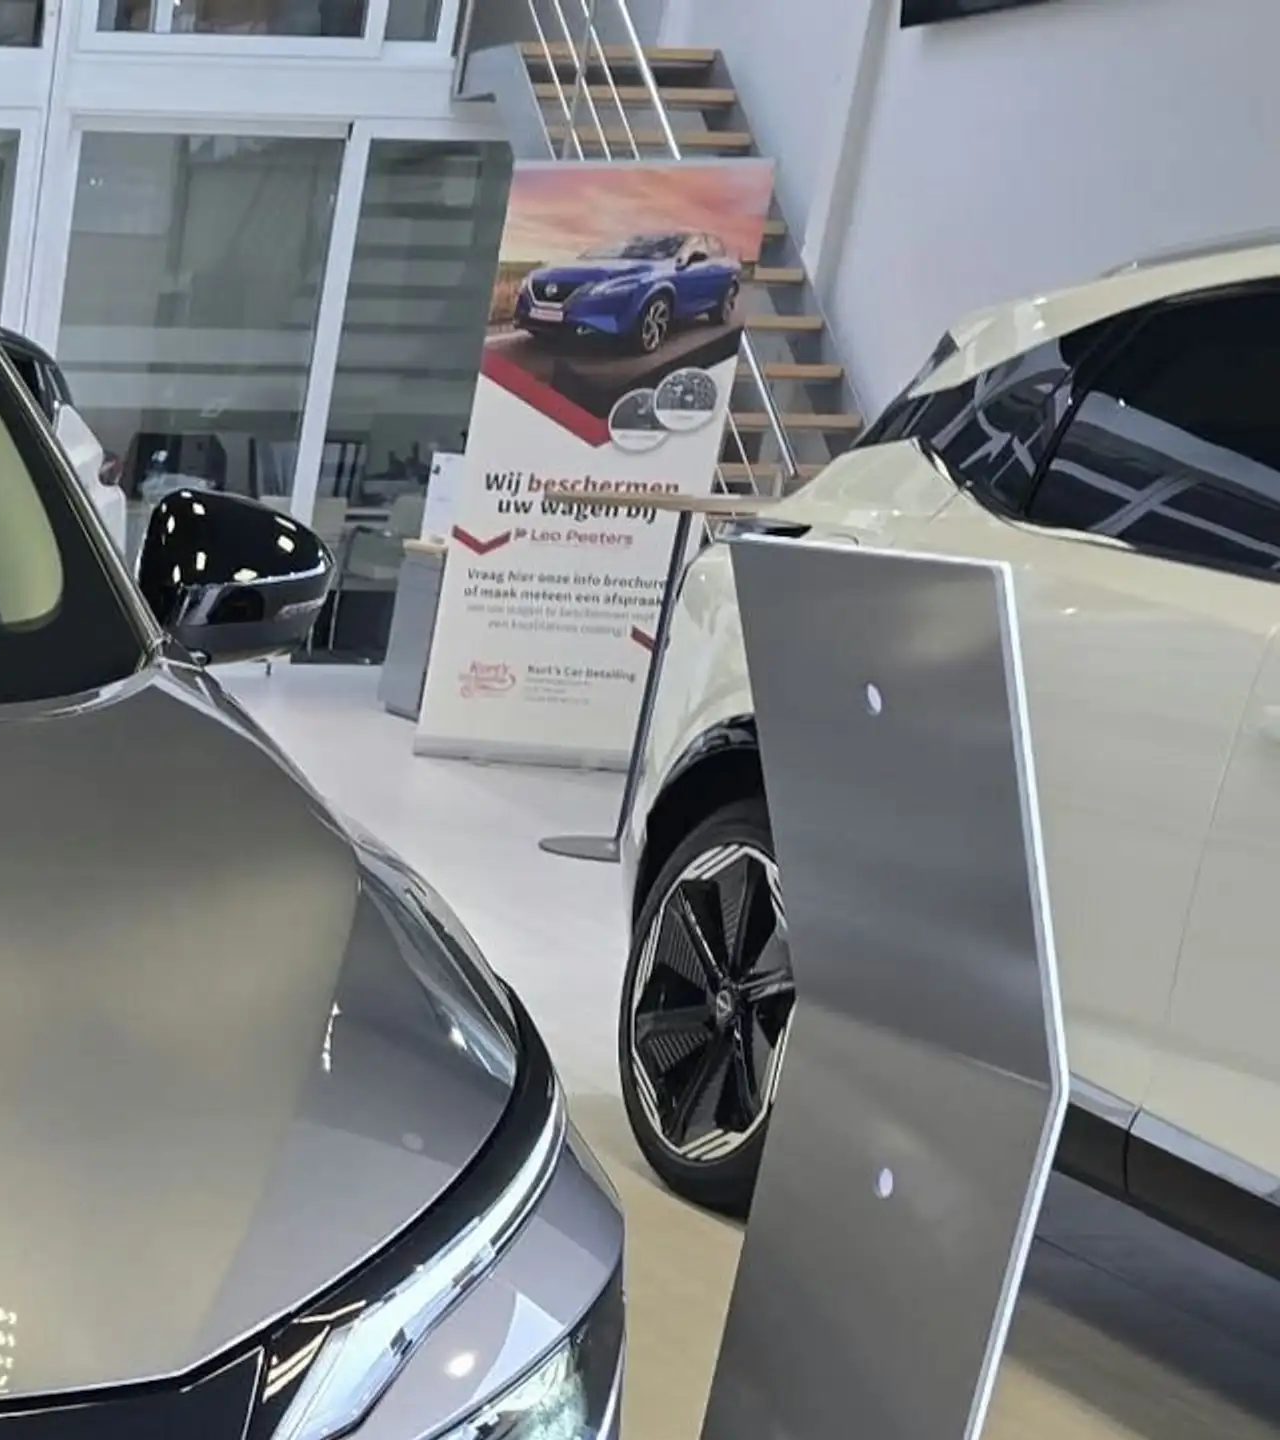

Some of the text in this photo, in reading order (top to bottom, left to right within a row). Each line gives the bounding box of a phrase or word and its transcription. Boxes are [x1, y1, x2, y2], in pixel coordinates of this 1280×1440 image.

[485, 472, 522, 497] Wij
[497, 498, 533, 514] uw
[531, 528, 634, 546] Leo Peeters
[467, 567, 505, 584] Vraag
[464, 585, 479, 598] of
[480, 585, 518, 599] maak
[574, 591, 600, 604] een
